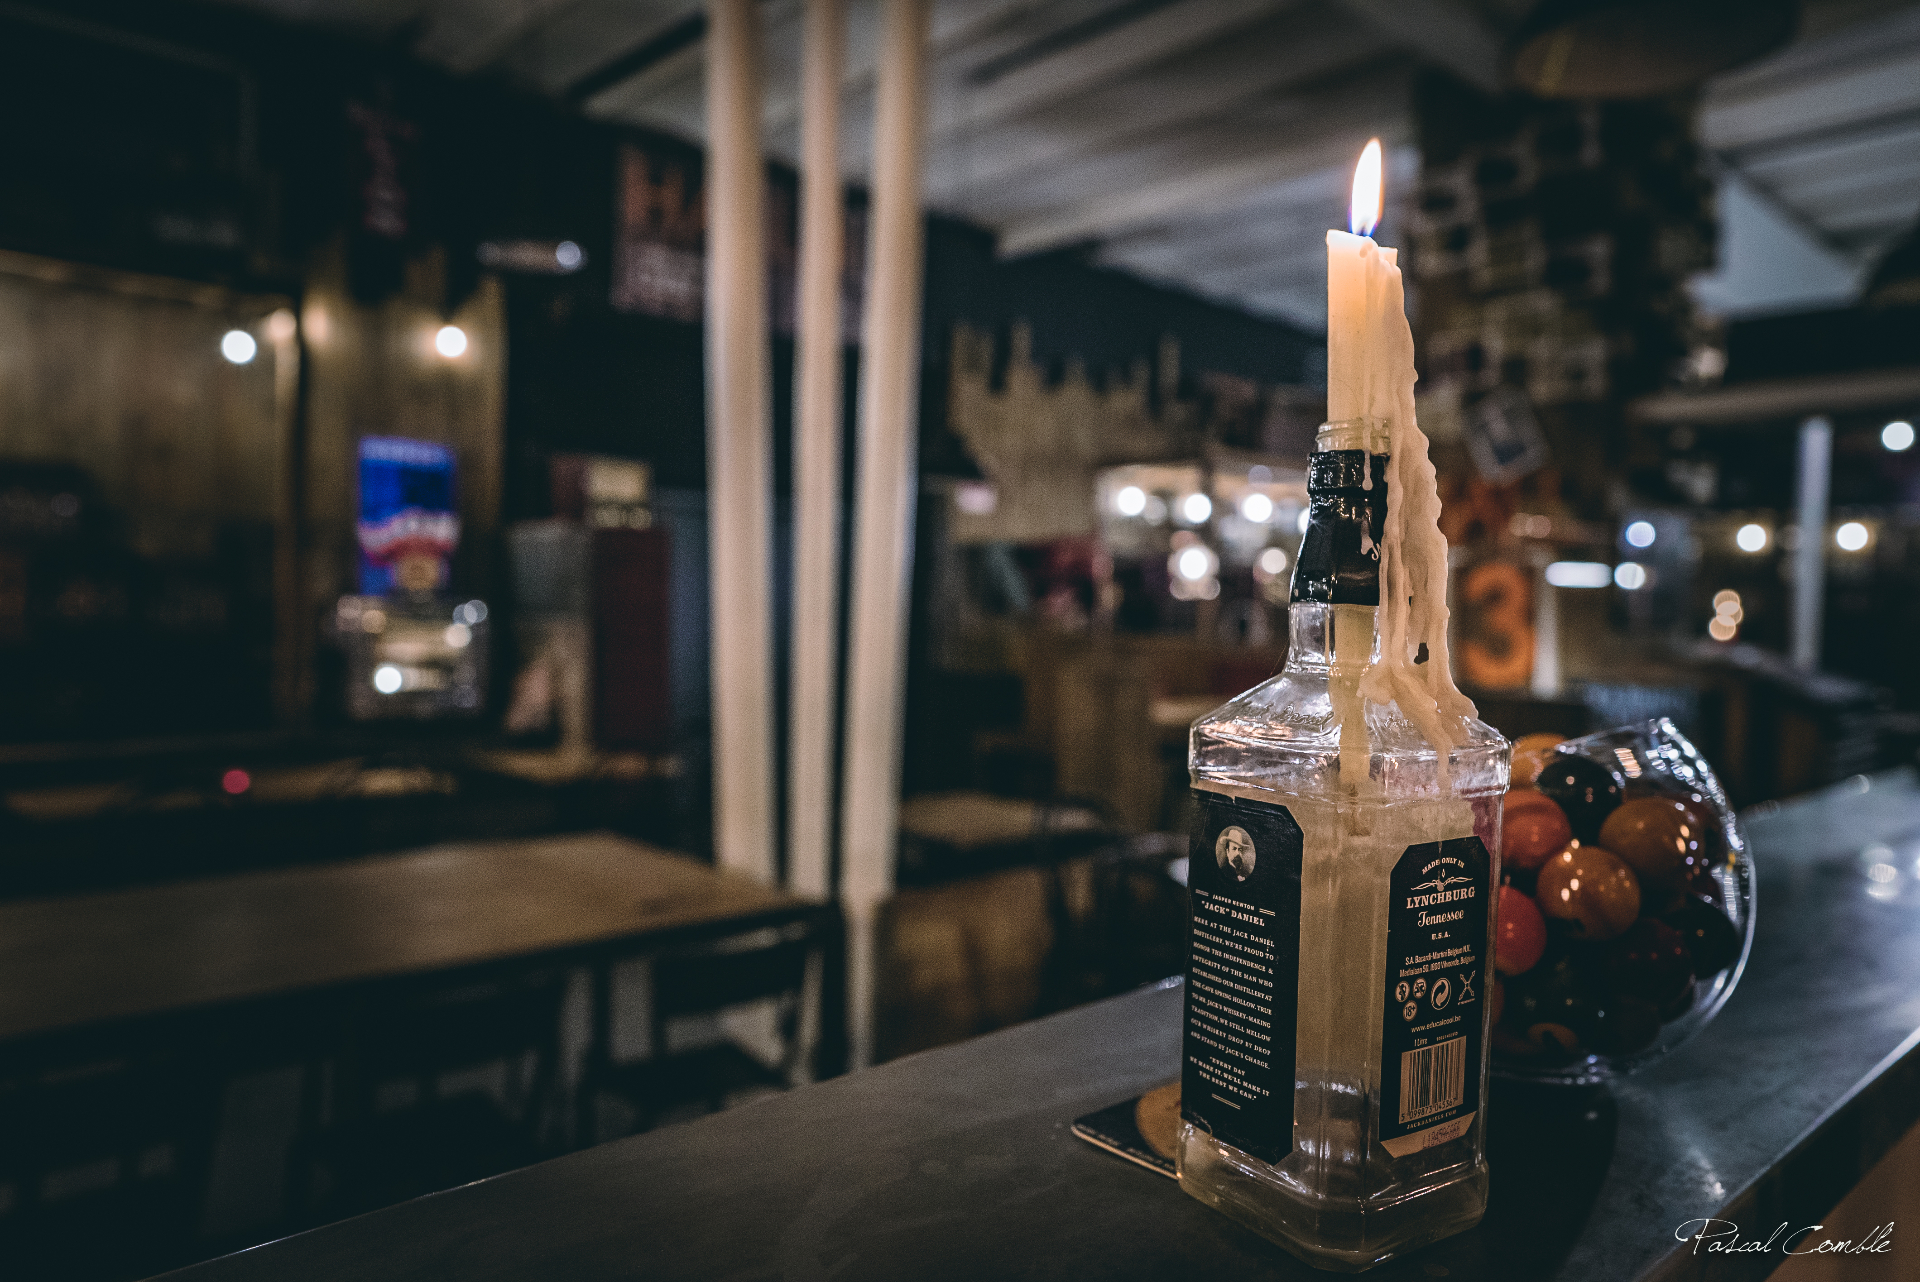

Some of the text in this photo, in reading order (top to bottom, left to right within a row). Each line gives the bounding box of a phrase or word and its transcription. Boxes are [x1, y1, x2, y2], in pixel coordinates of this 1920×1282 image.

[1422, 859, 1439, 875] MADE
[1458, 860, 1464, 868] IN
[1232, 901, 1254, 910] NEWTON
[1406, 886, 1475, 909] LYNCHBURG
[1202, 900, 1265, 926] "JACK" DANIEL
[1418, 910, 1464, 927] Tennessee
[1219, 925, 1231, 933] THE
[1233, 930, 1248, 939] JACK
[1432, 931, 1450, 940] U.S.A.
[1225, 940, 1242, 950] WE'RE
[1244, 945, 1264, 957] PROUD
[1212, 949, 1222, 957] THE
[1223, 952, 1266, 972] INDEPENDENCE
[1193, 954, 1220, 969] INTEGRITY
[1230, 969, 1242, 977] THE
[1244, 973, 1257, 982] MAN
[1258, 978, 1273, 988] WHO
[1223, 979, 1234, 987] OUR
[1257, 1005, 1272, 1015] TRUE
[1229, 1022, 1245, 1032] STILL
[1246, 1028, 1271, 1042] MELLOW
[1228, 1034, 1243, 1045] DROP
[1254, 1045, 1271, 1055] DROP
[1190, 1056, 1197, 1064] WE
[1198, 1061, 1214, 1072] MAKE
[1243, 1081, 1260, 1093] MAKE
[1233, 1067, 1245, 1076] DAY
[1199, 1071, 1210, 1080] THE
[1212, 1077, 1227, 1087] BEST
[1228, 1085, 1238, 1093] WE
